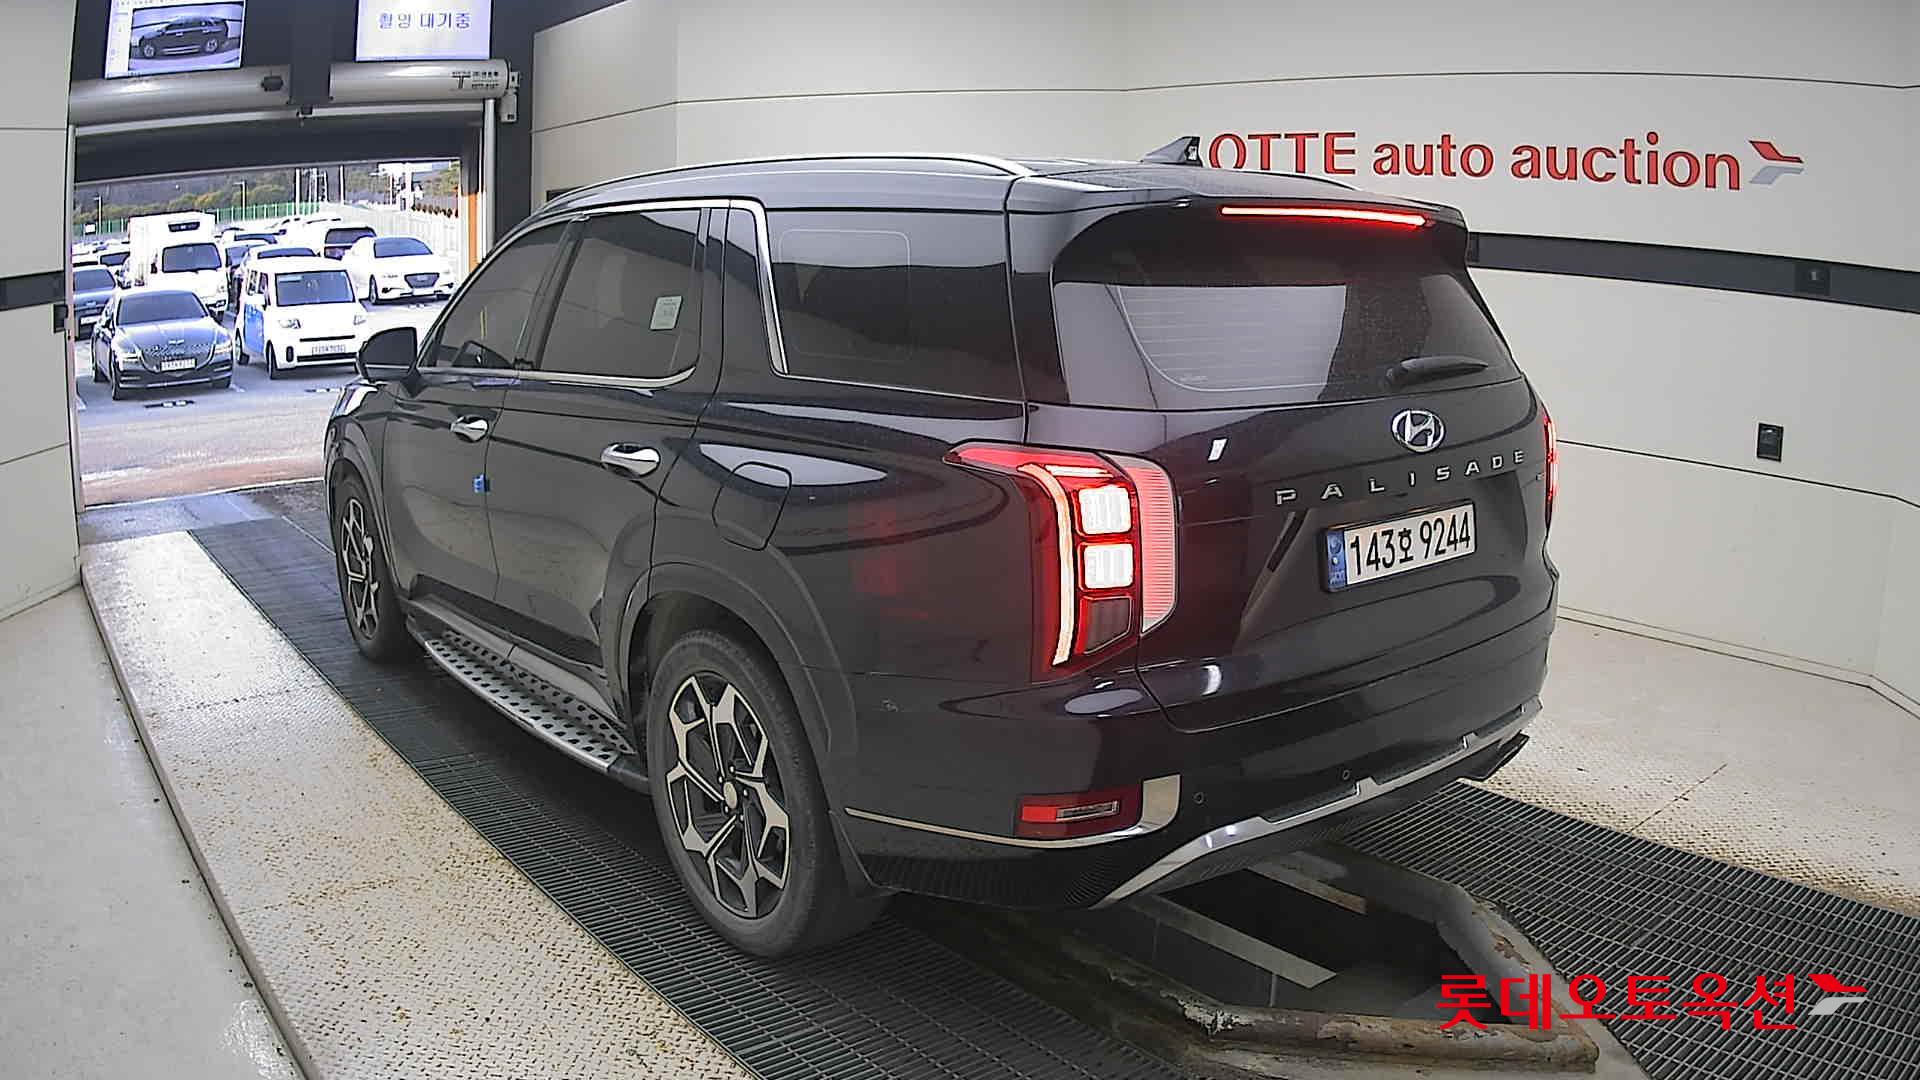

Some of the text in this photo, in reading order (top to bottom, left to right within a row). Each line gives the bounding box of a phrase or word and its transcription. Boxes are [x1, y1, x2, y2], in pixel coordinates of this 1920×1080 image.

[420, 12, 470, 29] 대기중
[1208, 131, 1740, 191] OTTE auto auction
[1275, 450, 1526, 505] PALISADE
[1350, 511, 1471, 576] 143호 9244
